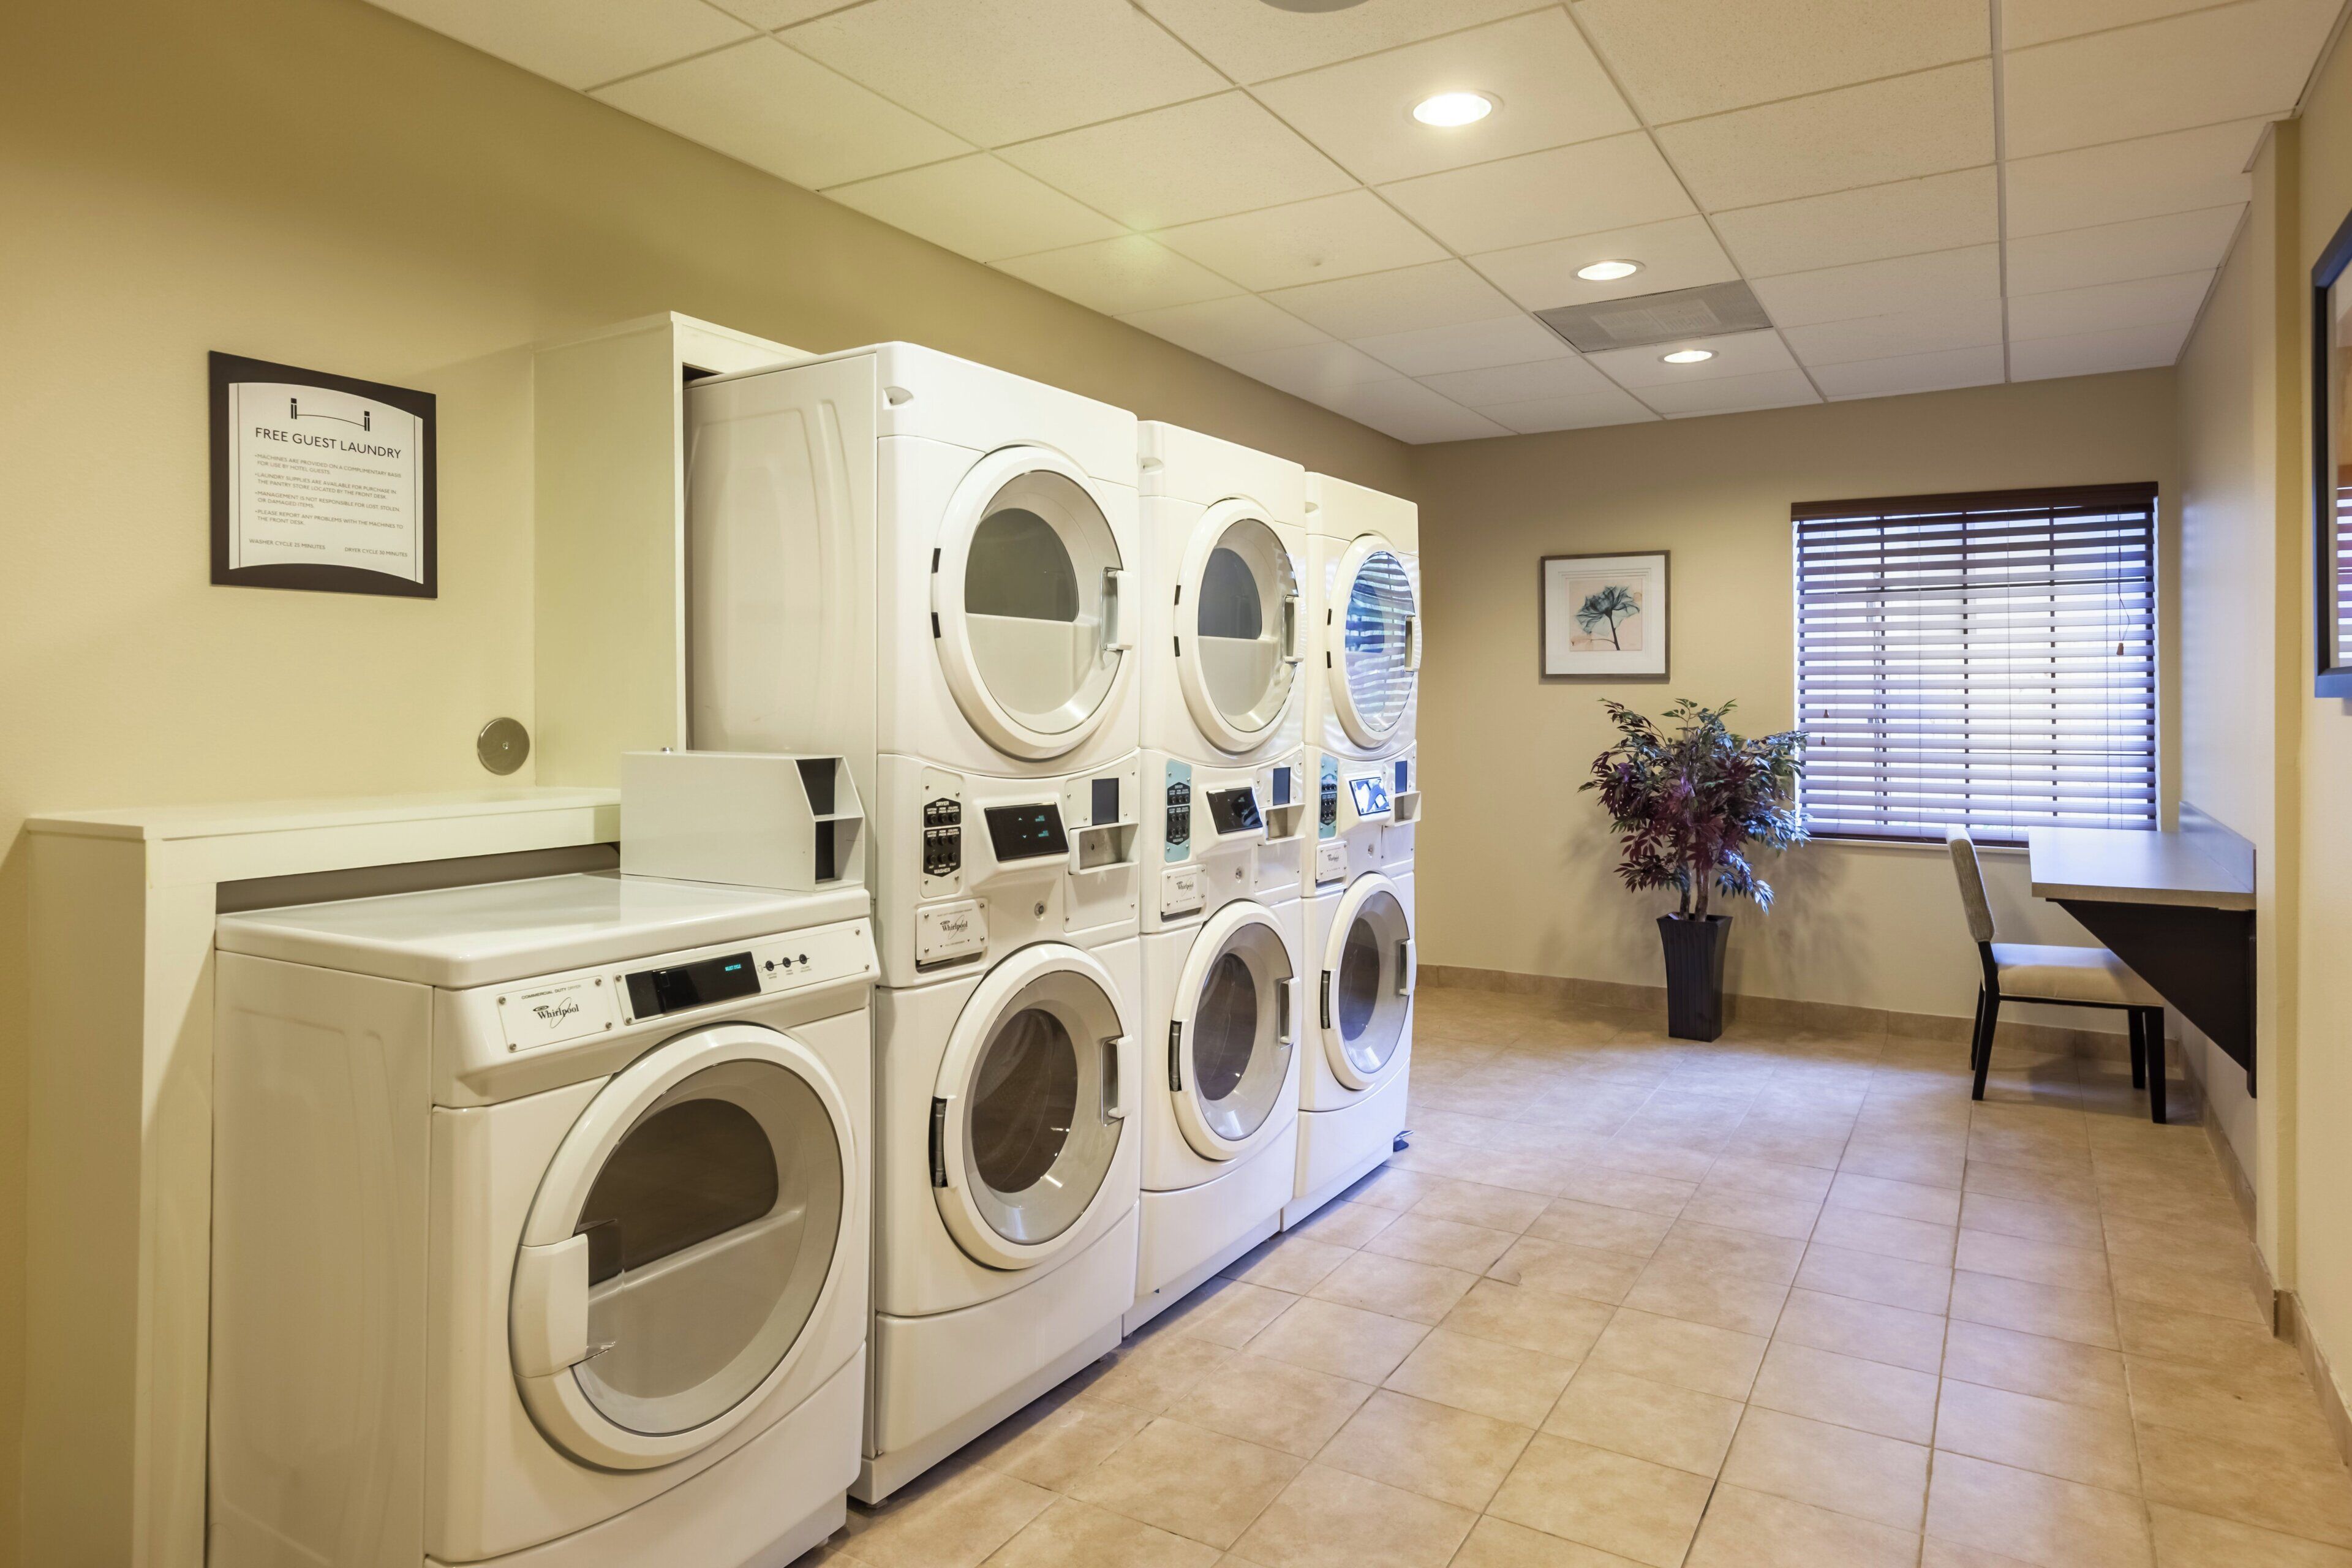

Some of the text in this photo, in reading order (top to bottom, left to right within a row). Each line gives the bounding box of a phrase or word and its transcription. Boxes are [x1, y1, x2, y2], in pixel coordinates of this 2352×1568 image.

[256, 428, 401, 458] FREE GUEST LAUNDRY
[344, 466, 387, 475] COMPLIMENTARY
[319, 498, 353, 507] RESPONSIBLE
[942, 921, 968, 931] Whirlpool
[521, 990, 552, 1000] COMMERCIAL
[537, 1004, 579, 1019] Whirlpool
